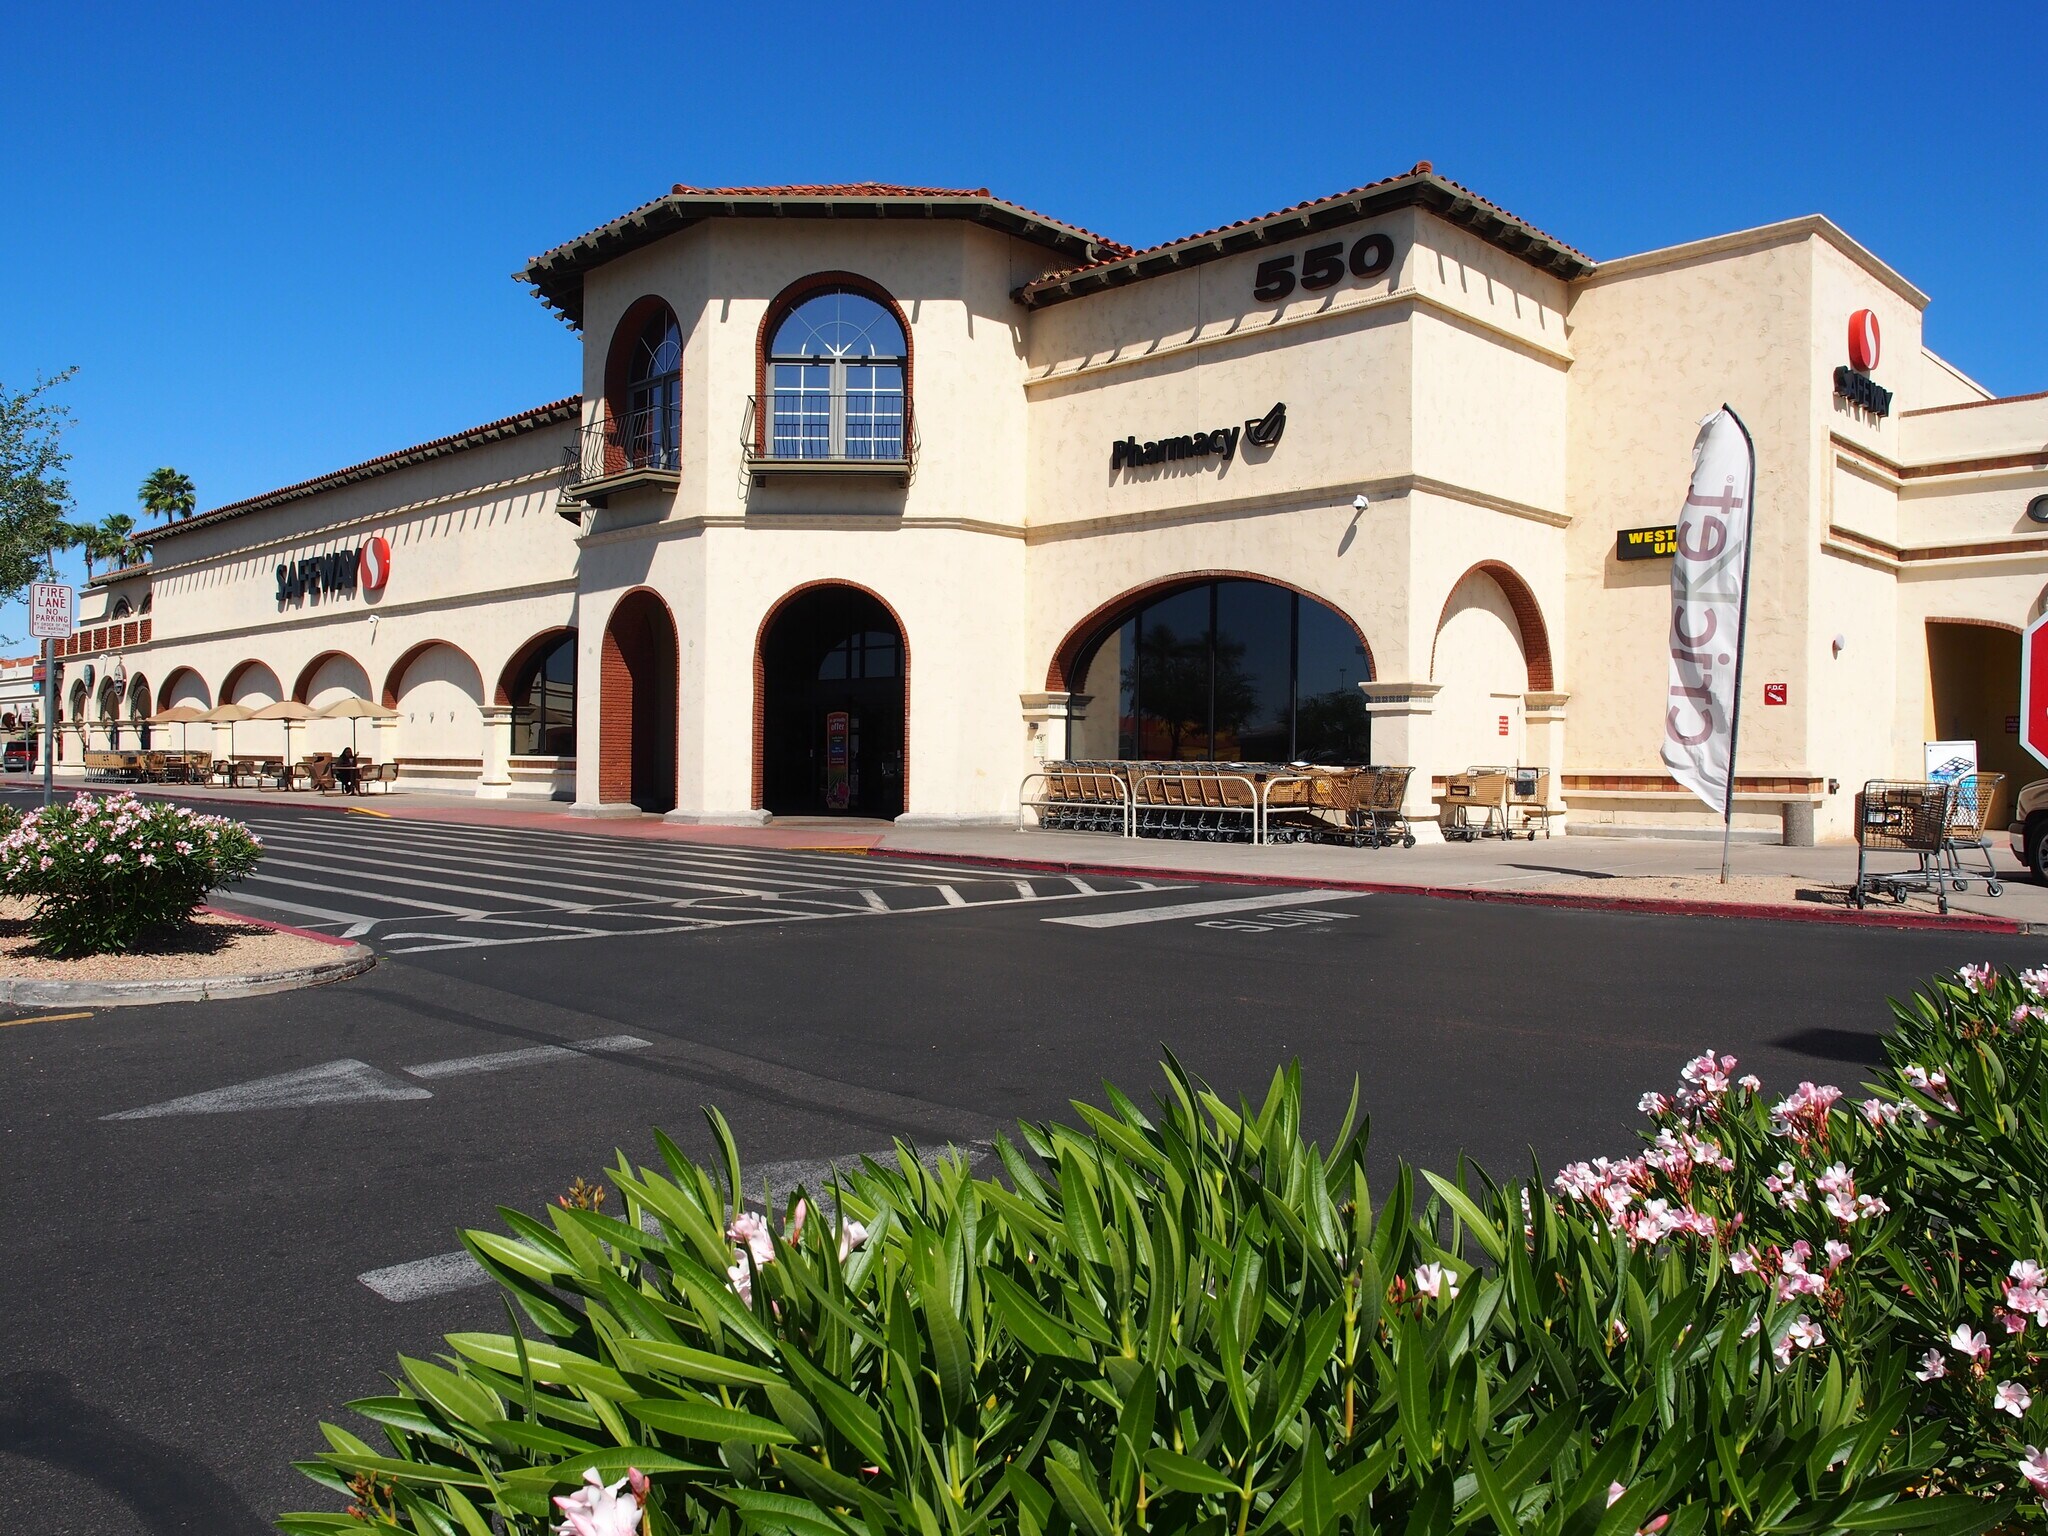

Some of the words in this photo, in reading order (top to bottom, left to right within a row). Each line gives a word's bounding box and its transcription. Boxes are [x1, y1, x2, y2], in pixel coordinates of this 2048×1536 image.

[1253, 233, 1395, 303] 550
[1832, 365, 1893, 418] SAFEWAY
[1112, 426, 1241, 470] Pharmacy
[1628, 529, 1676, 544] WEST
[1654, 541, 1678, 554] UN
[276, 548, 362, 601] SAFEWAY
[40, 586, 65, 598] FIRE
[38, 597, 66, 609] LANE
[46, 608, 58, 616] NO
[36, 614, 69, 623] PARKING
[1667, 485, 1743, 746] cricket
[1194, 908, 1361, 933] SLOW
